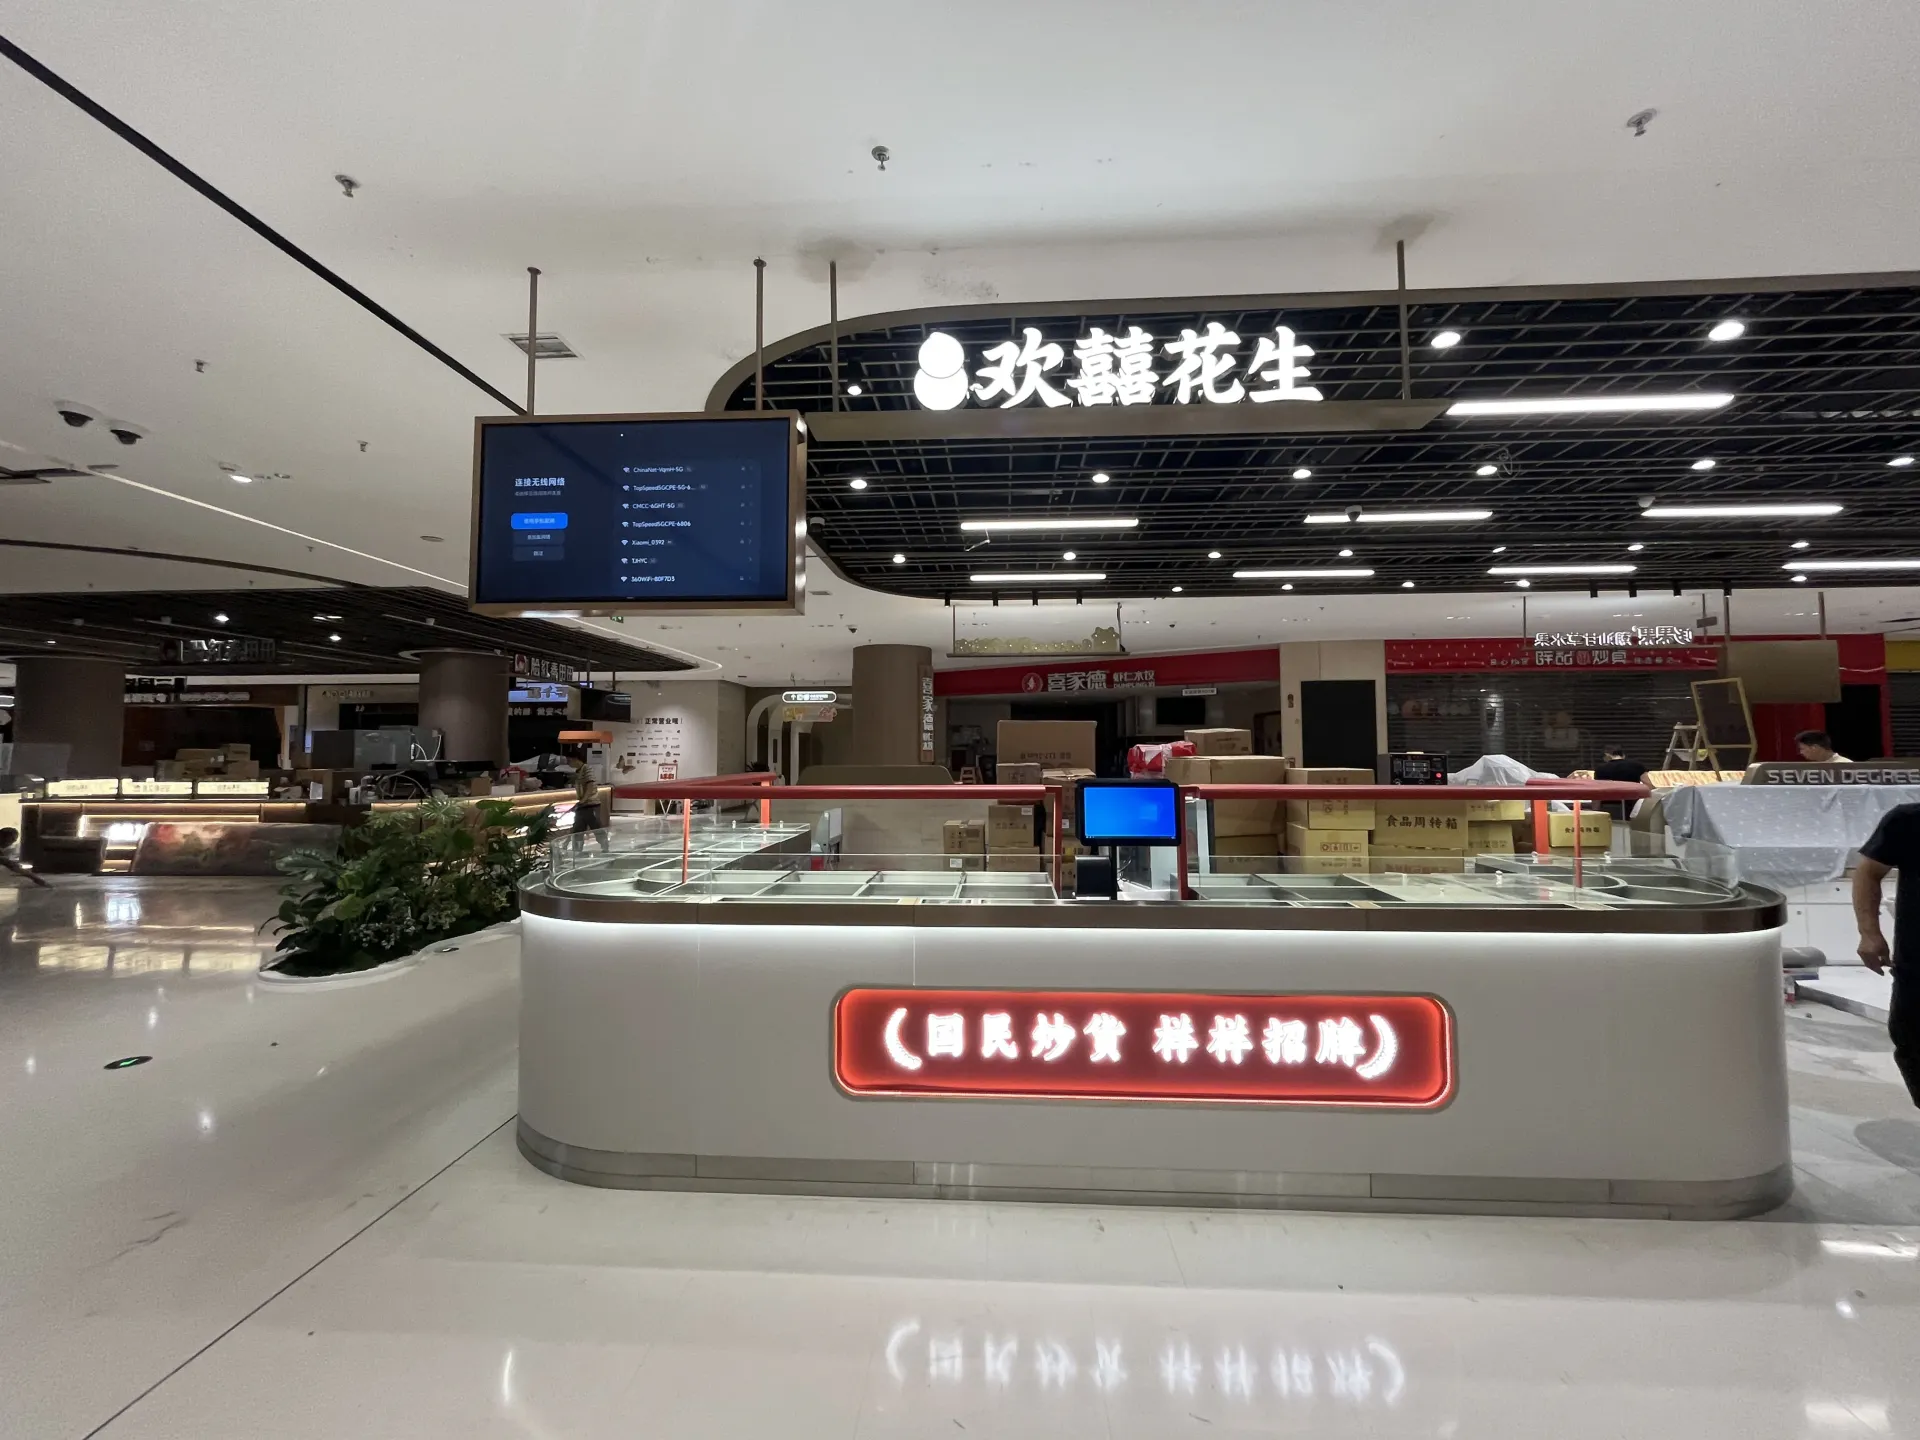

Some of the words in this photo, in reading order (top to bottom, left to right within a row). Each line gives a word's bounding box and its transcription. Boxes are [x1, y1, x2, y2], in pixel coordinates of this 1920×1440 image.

[969, 322, 1324, 409] 欢囍花生
[514, 477, 566, 487] 连接无线网络
[1047, 670, 1107, 691] 喜家德
[1767, 769, 1834, 784] SEVEN
[1385, 814, 1458, 830] 食品周转箱
